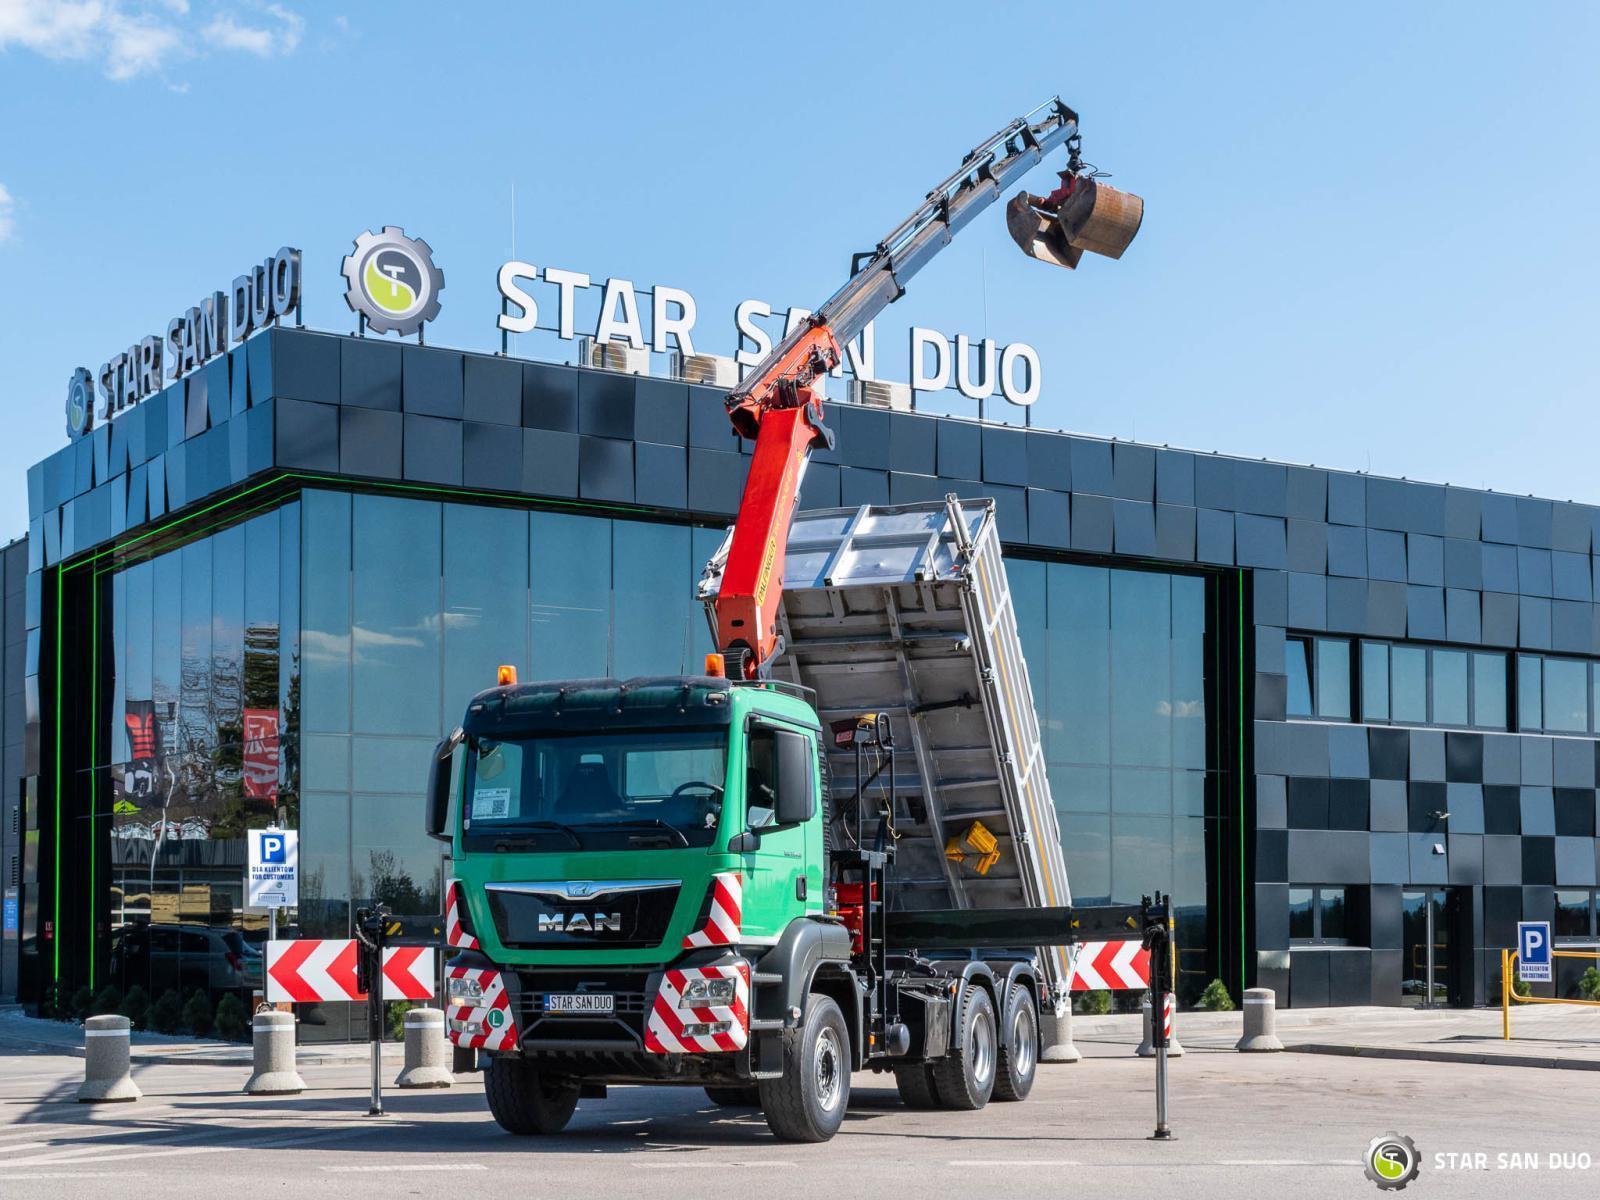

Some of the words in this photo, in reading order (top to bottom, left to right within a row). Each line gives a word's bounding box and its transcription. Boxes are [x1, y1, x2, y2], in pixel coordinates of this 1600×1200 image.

[98, 335, 163, 420] STAR
[167, 290, 228, 379] SAN
[232, 246, 300, 342] DUO
[497, 260, 697, 357] STAR
[910, 326, 1041, 406] DUO
[758, 540, 777, 603] PALFINGER
[264, 838, 281, 860] P
[538, 912, 621, 932] MAN
[1525, 930, 1543, 958] P
[551, 996, 573, 1010] STAR
[576, 996, 592, 1010] SAN
[594, 996, 612, 1010] DUO
